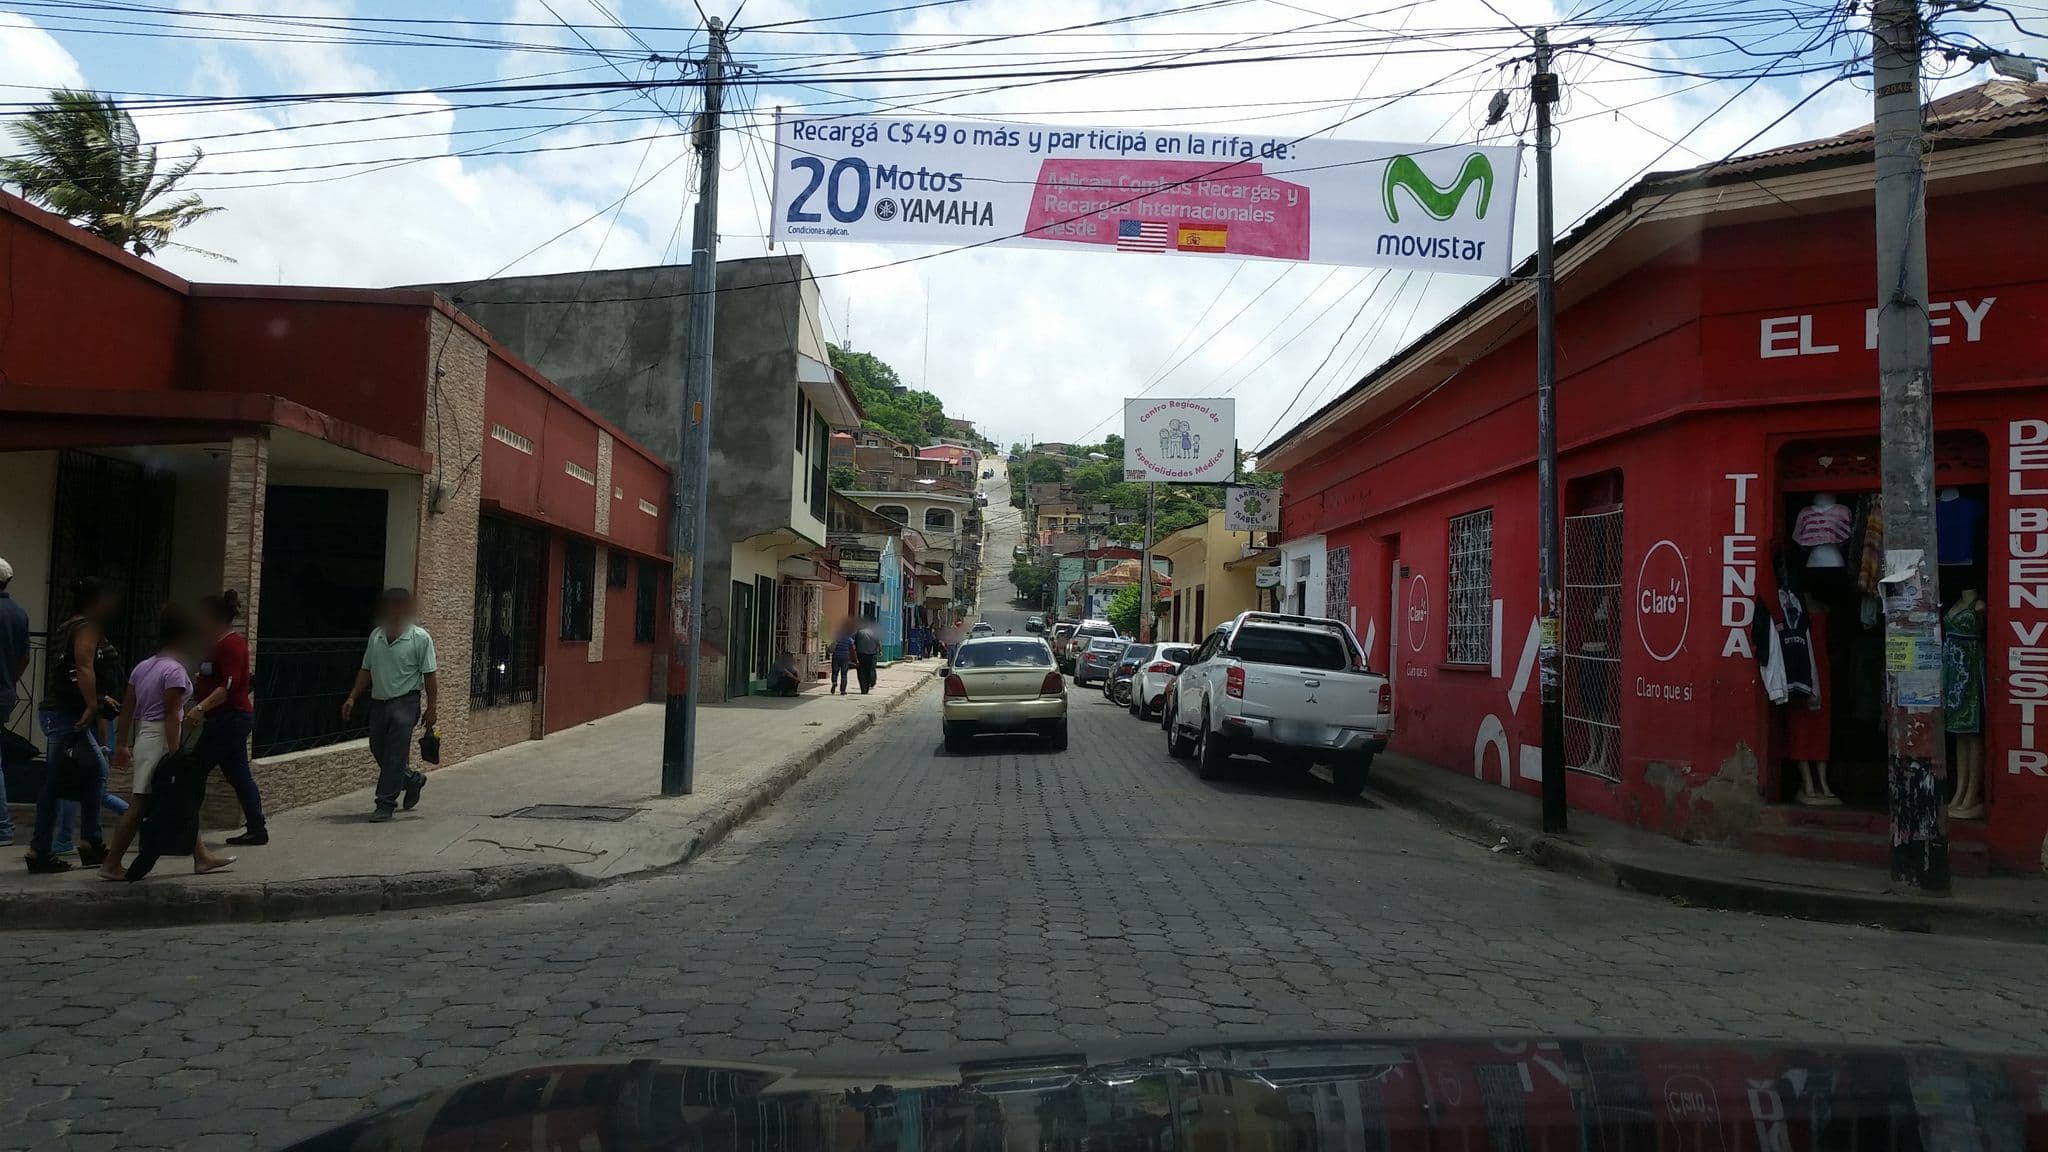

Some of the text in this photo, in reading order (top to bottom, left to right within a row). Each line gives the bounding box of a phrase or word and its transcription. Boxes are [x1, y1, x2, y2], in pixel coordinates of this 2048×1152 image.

[793, 121, 1296, 160] Recargá C$49 o más y participá en la rifa de:
[786, 157, 871, 223] 20
[875, 164, 963, 192] Motos
[1046, 172, 1299, 207] Aplican Combos Recargas y
[900, 198, 994, 226] YAMAHA
[1044, 195, 1275, 223] Recargas Internacionales
[787, 225, 825, 235] Condiciones
[1043, 219, 1097, 236] desde
[1376, 234, 1486, 261] movistar
[1760, 296, 1997, 359] EL EY
[1140, 400, 1220, 423] Centro Regional de
[1134, 447, 1193, 478] Especialidades
[1234, 489, 1272, 504] FARMACIA
[1233, 510, 1260, 524] ISABEL
[1721, 473, 1759, 659] TIENDA
[1641, 588, 1678, 614] Claro
[2007, 419, 2048, 777] DEL BUEN VESTIR
[1636, 676, 1661, 698] Claro
[1663, 683, 1681, 704] que
